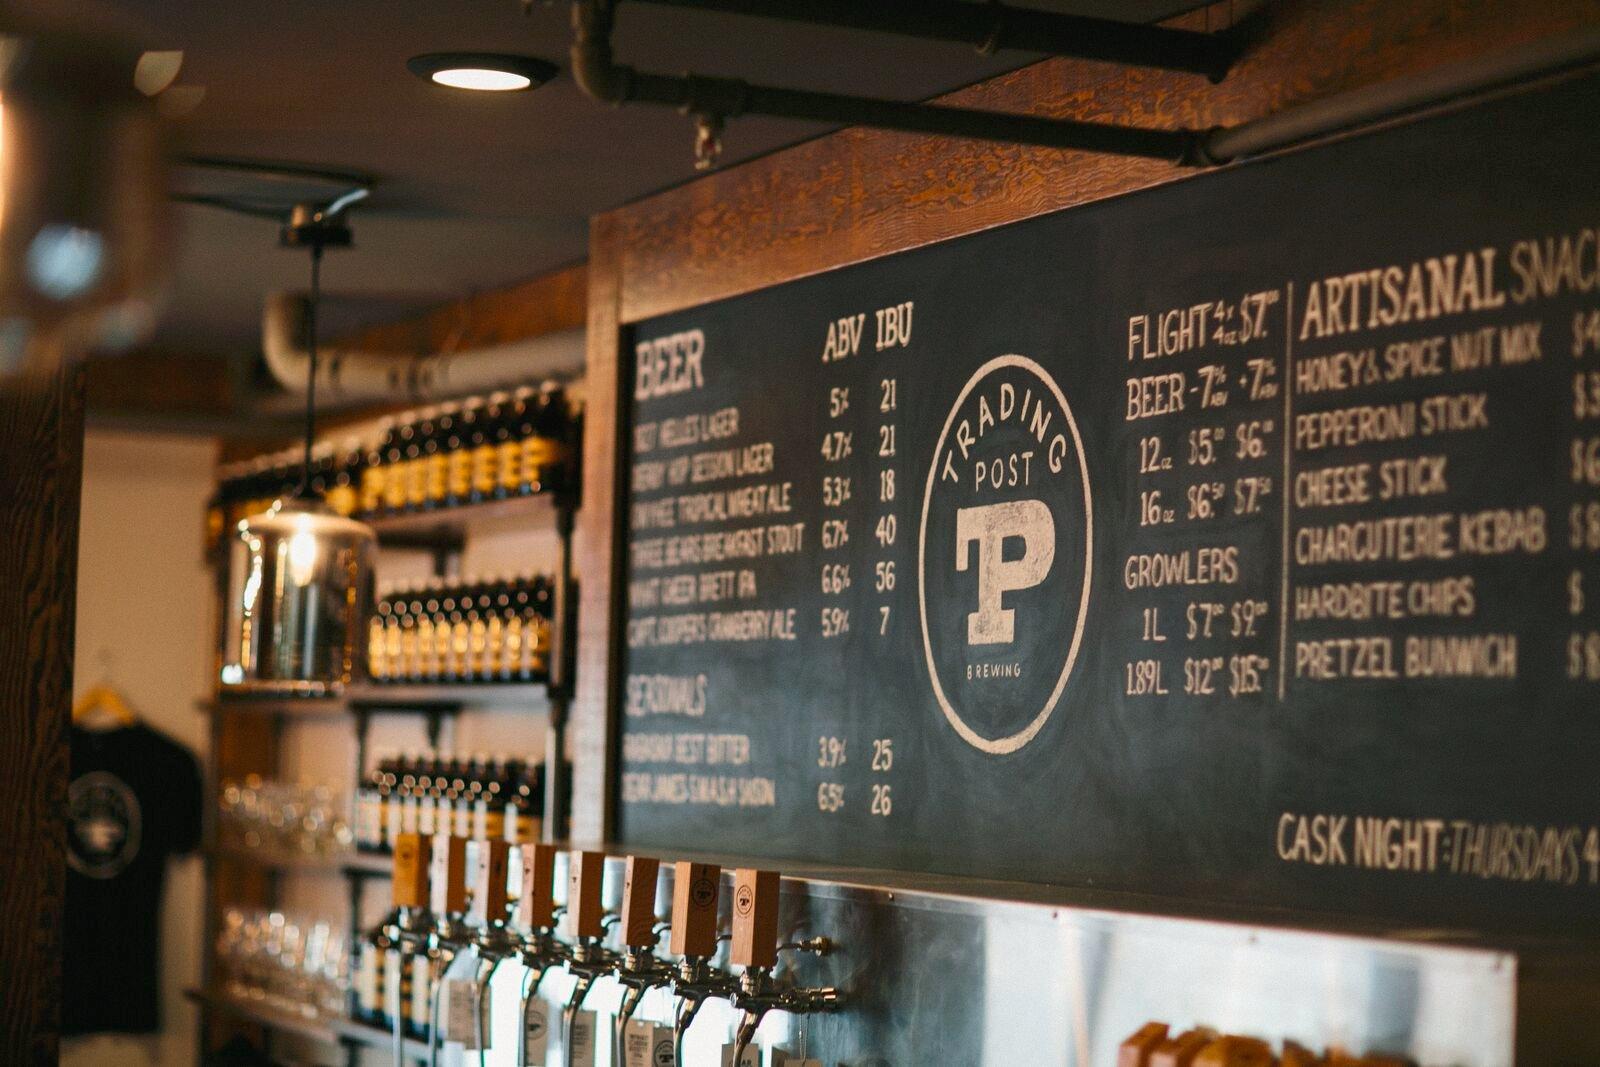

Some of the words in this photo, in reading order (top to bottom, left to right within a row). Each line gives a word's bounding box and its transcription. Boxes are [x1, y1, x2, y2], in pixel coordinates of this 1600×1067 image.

[1300, 247, 1505, 341] ARTISANAL
[1510, 228, 1600, 303] SNAC
[822, 313, 865, 363] ABV
[876, 301, 913, 351] IBU
[1128, 302, 1213, 361] FLIGHT
[635, 329, 704, 400] BEER
[1384, 336, 1445, 383] SPICE
[1451, 327, 1496, 370] NUT
[830, 387, 849, 418] 5%
[880, 379, 896, 412] 21
[1126, 372, 1185, 421] BEER
[879, 424, 895, 456] 21
[942, 383, 1066, 483] TRADING
[1297, 402, 1416, 449] PEPPERONI
[1421, 393, 1488, 436] STICK
[880, 469, 895, 501] 18
[975, 451, 1033, 492] POST
[1295, 463, 1371, 508] CHEESE
[1380, 455, 1447, 500] STICK
[875, 514, 896, 547] 40
[1296, 514, 1454, 565] CHARCUTERIE
[1459, 506, 1547, 554] KEBAB
[876, 561, 895, 592] 56
[1125, 546, 1239, 590] GROWLERS
[1296, 582, 1405, 620] HARDBITE
[1407, 575, 1475, 616] CHIPS
[880, 606, 890, 635] 7
[1142, 608, 1167, 641] 1L
[966, 663, 1021, 680] BREWING
[1296, 636, 1398, 680] PRETZEL
[872, 739, 893, 771] 25
[871, 784, 892, 816] 26
[1277, 813, 1347, 866] CASK
